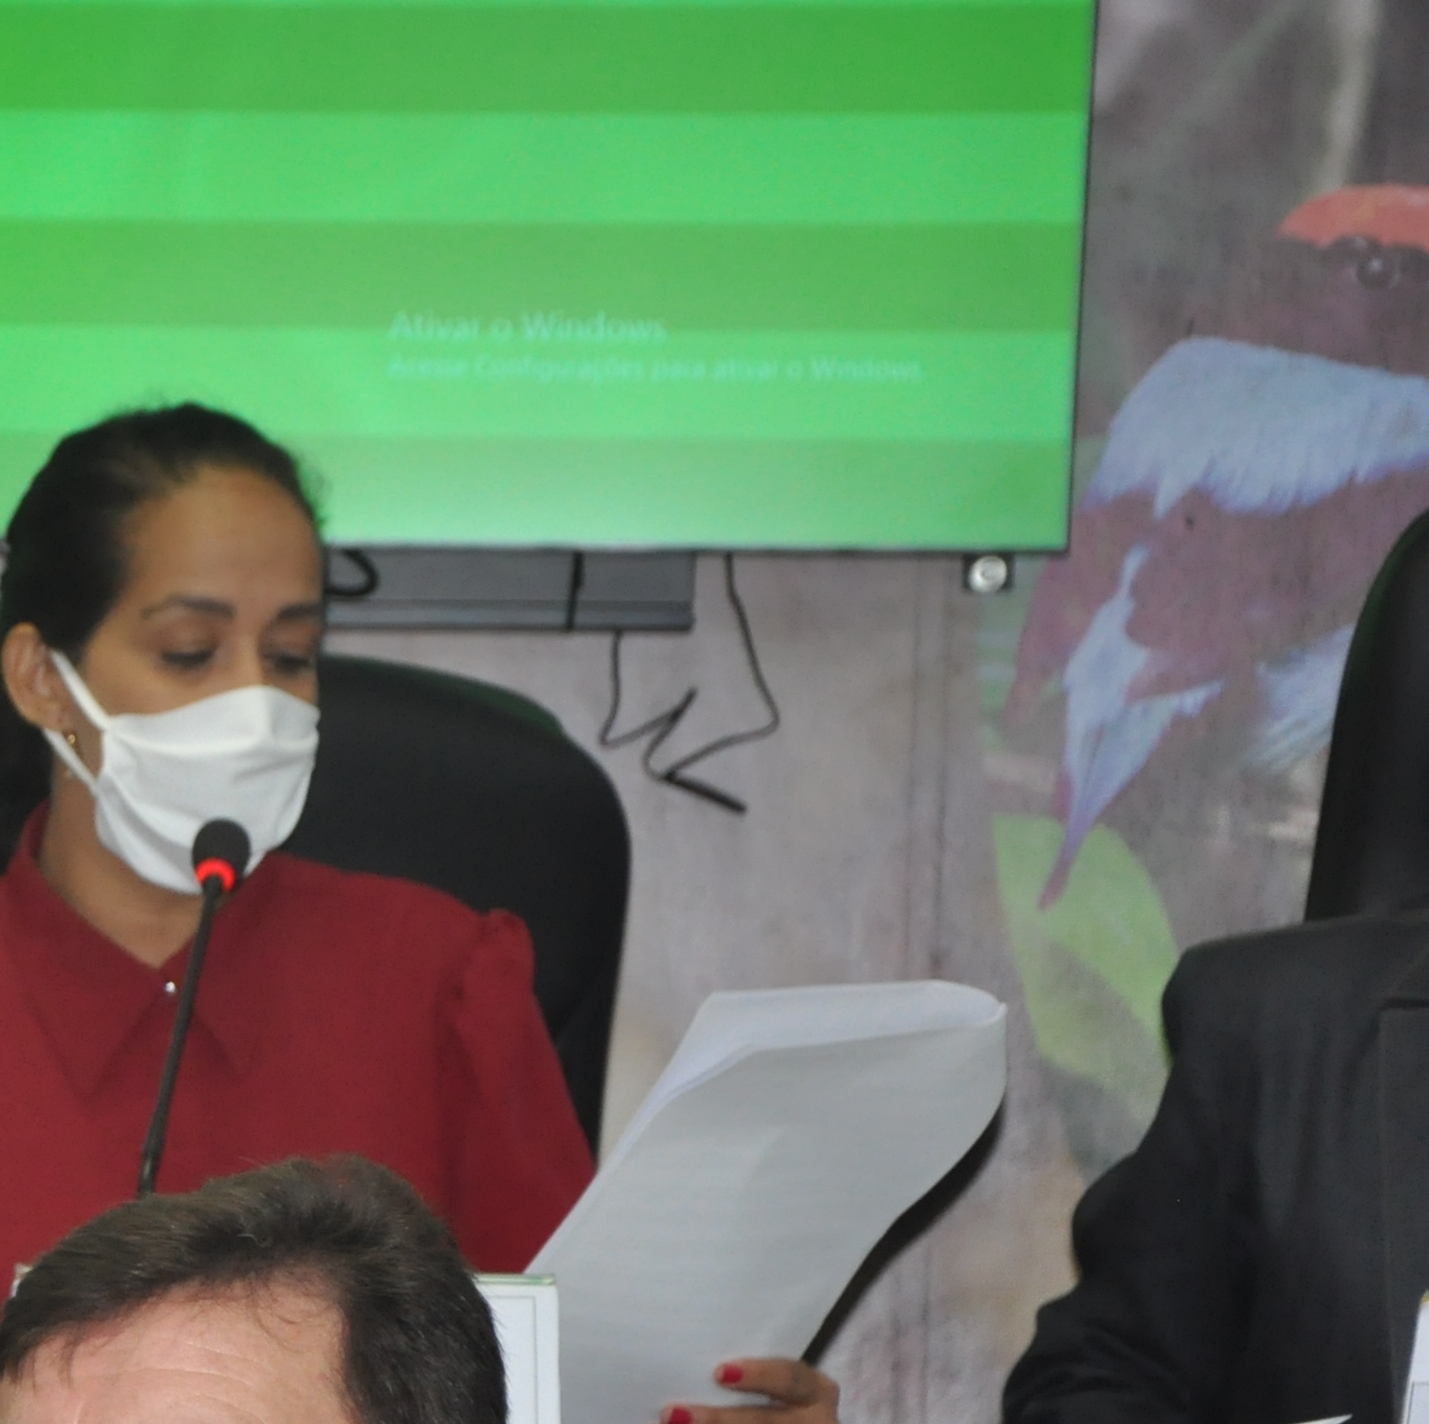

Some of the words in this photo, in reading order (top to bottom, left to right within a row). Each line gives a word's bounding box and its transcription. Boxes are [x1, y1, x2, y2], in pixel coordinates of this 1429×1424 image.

[387, 310, 479, 343] Ativar
[491, 319, 513, 343] o
[521, 310, 668, 345] Windows
